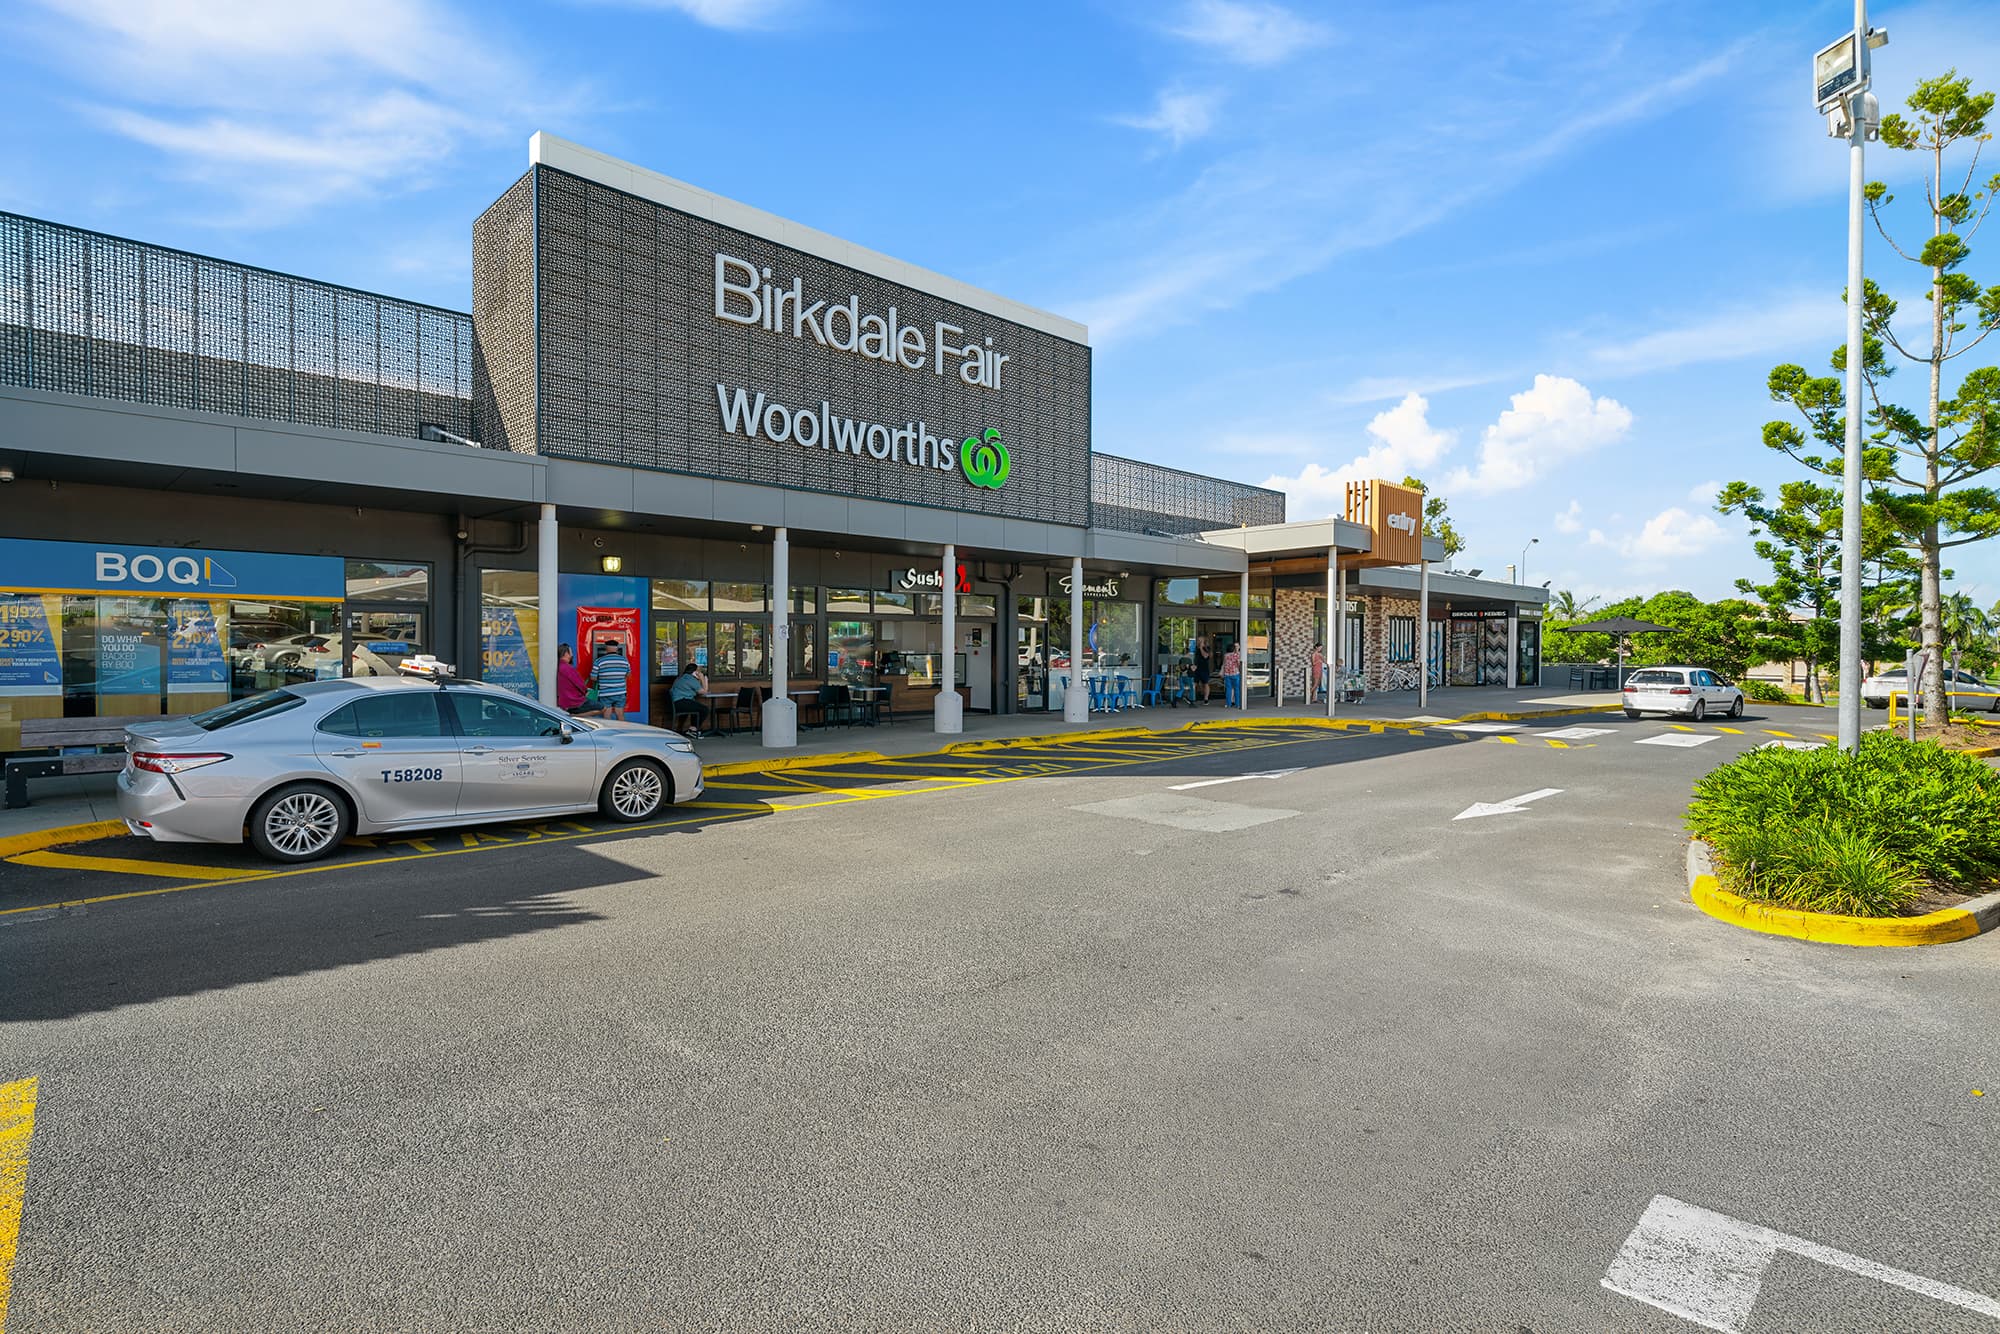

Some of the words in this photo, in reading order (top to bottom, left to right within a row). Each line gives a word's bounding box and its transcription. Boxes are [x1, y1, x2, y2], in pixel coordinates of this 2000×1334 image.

[714, 252, 926, 370] Birkdale
[935, 321, 1010, 390] Fair
[716, 384, 954, 471] Woolworths
[1387, 511, 1416, 537] entry
[95, 551, 200, 586] BOQ
[900, 567, 944, 589] Sush
[1058, 576, 1118, 597] Eements
[102, 635, 115, 643] DO
[116, 635, 143, 643] WHAT
[102, 644, 120, 652] YOU
[122, 644, 135, 652] DO
[102, 652, 137, 660] BACKED
[102, 661, 113, 669] BY
[498, 755, 521, 763] Silver
[521, 753, 547, 762] Service
[381, 770, 391, 783] T
[394, 768, 443, 782] 58208
